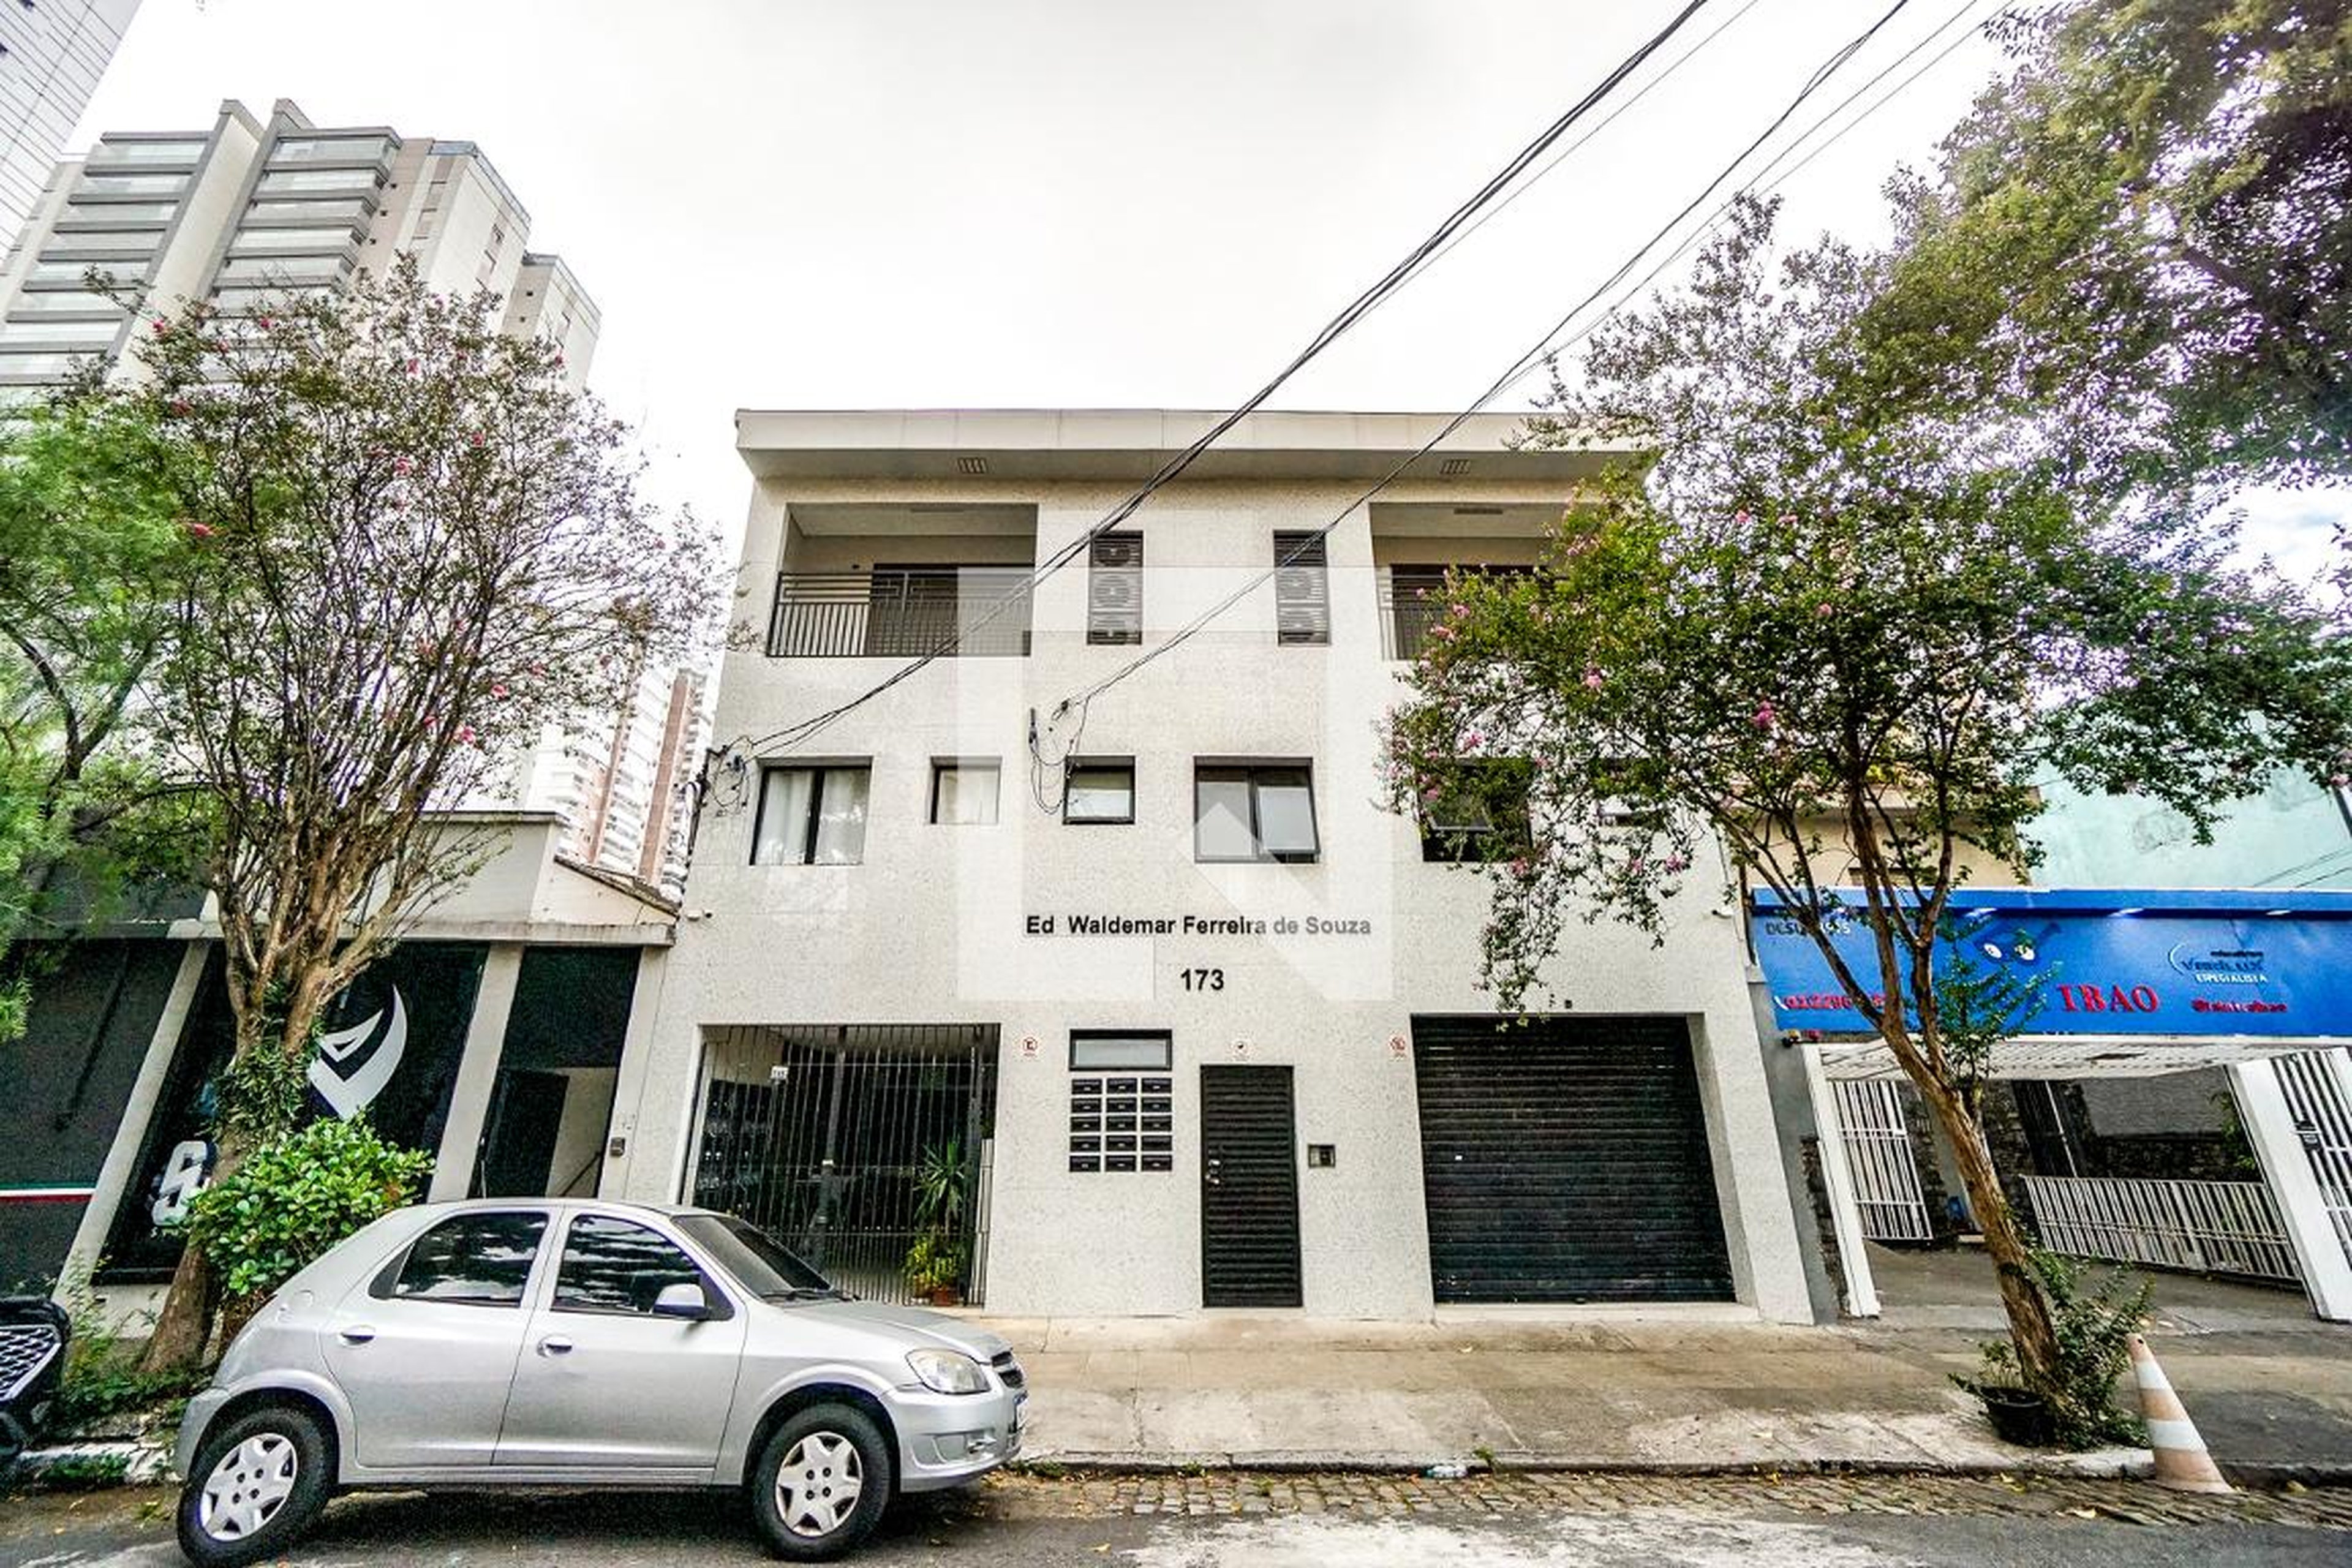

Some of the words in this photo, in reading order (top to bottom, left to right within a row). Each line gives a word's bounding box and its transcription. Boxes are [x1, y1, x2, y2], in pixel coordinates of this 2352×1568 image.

[1026, 916, 1055, 934] Ed
[1068, 916, 1176, 934] Waldemar
[1183, 916, 1267, 934] Ferreira
[1273, 916, 1298, 934] de
[1305, 916, 1372, 935] Souza
[1181, 969, 1224, 991] 173
